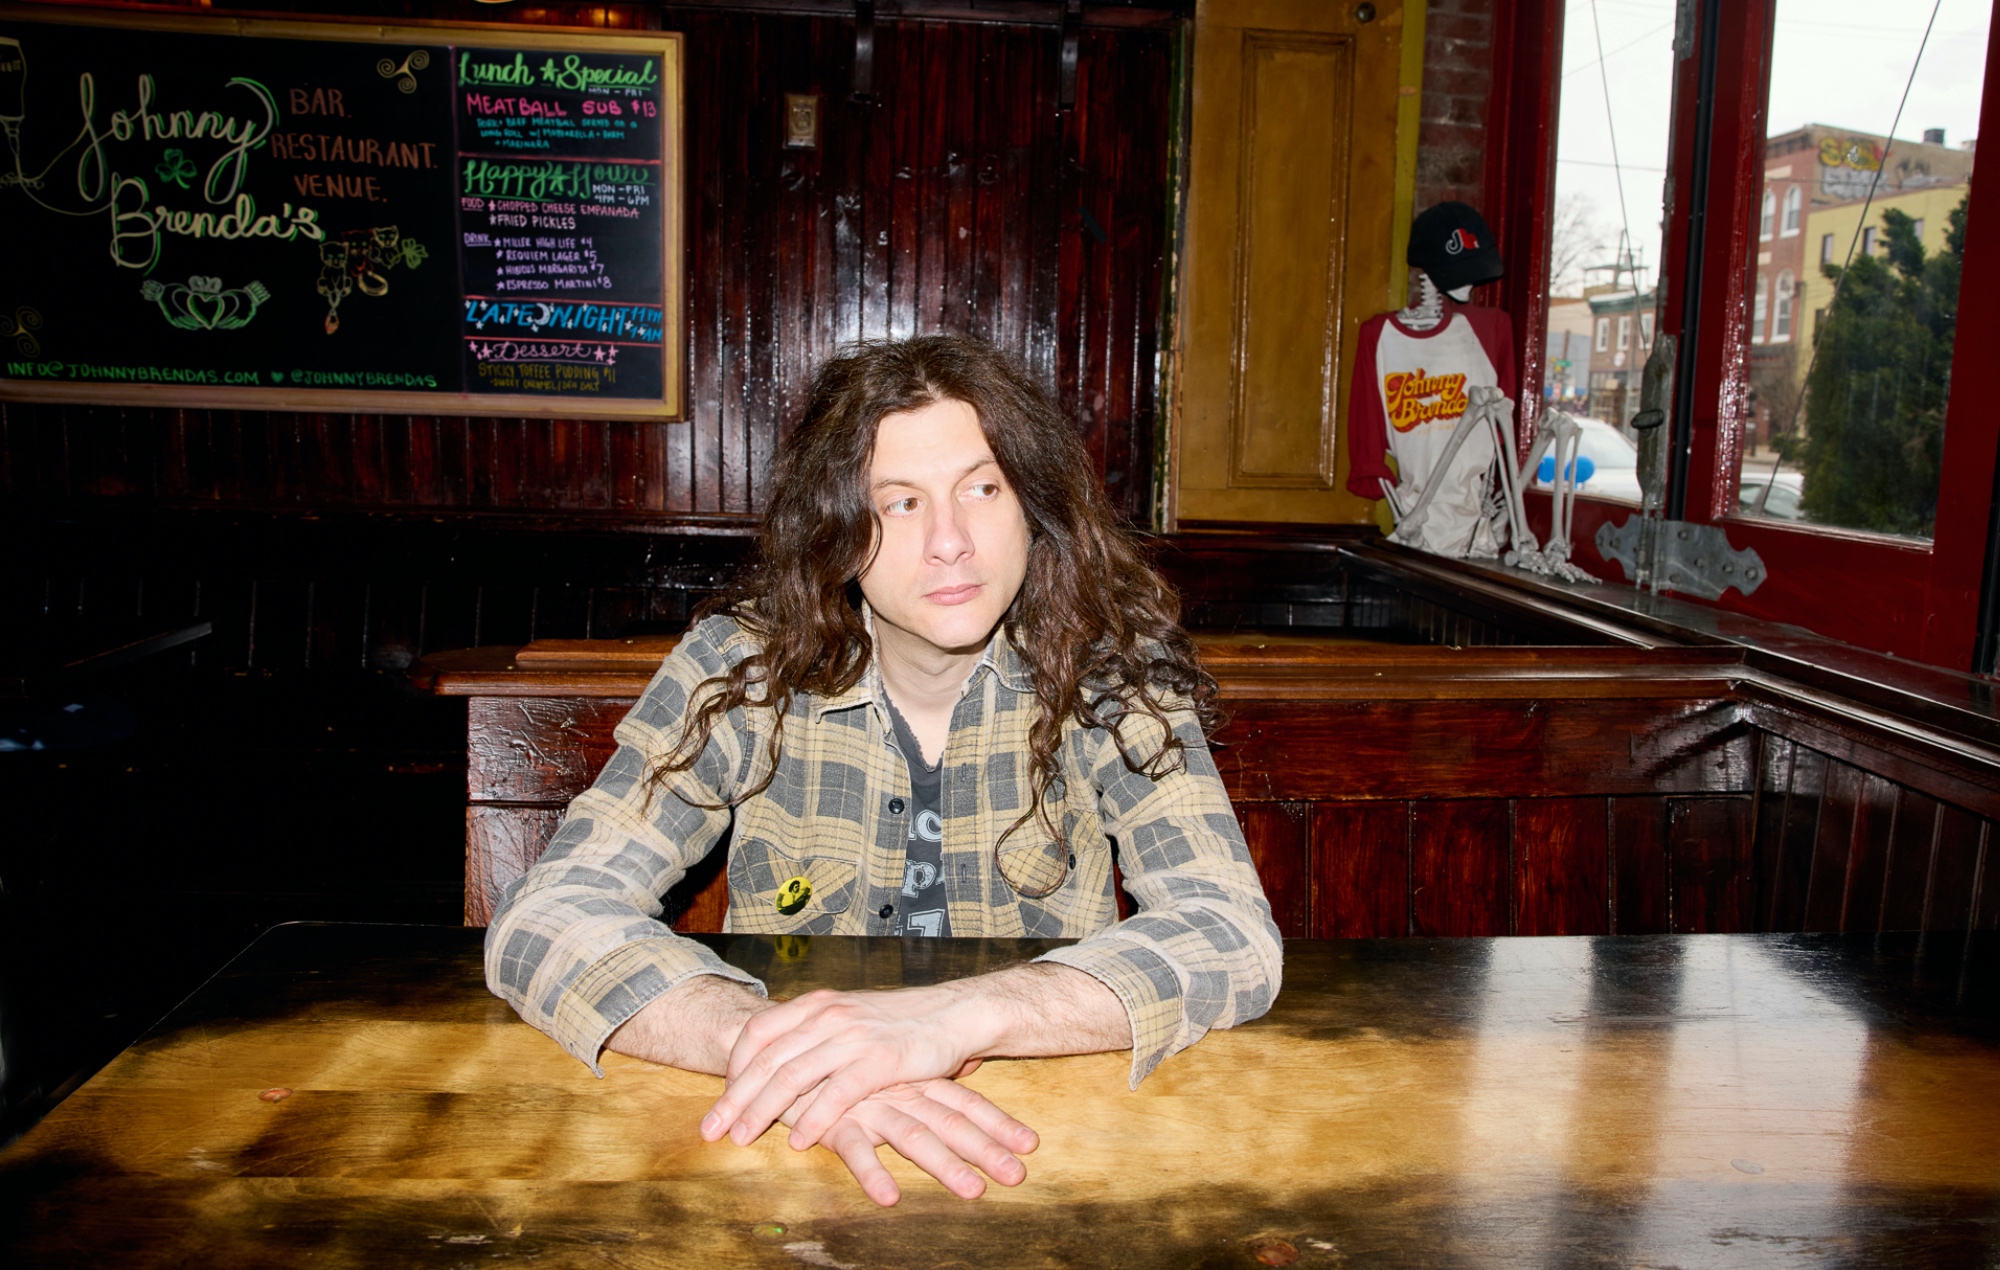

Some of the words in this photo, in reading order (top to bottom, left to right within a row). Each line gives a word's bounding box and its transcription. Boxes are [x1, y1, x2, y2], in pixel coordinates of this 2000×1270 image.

[458, 51, 536, 88] Lunch
[555, 54, 658, 93] Special
[289, 88, 352, 119] BAR.
[582, 99, 624, 116] SUB
[78, 72, 279, 204] Johnny
[270, 133, 439, 169] RESTAURANT.
[294, 174, 388, 203] VENUE.
[463, 158, 554, 200] Happy
[567, 162, 650, 200] Hour
[592, 184, 616, 194] MON
[625, 185, 646, 195] FRI
[460, 197, 485, 210] FOOD
[497, 200, 539, 213] CHOPPED
[541, 202, 577, 215] CHEESE
[579, 204, 641, 219] EMPANADA
[110, 172, 326, 275] Brenda's
[497, 214, 528, 228] FRIED
[531, 215, 577, 229] PICKLES
[502, 236, 532, 249] MILLER
[535, 236, 556, 249] HIGH
[557, 237, 576, 249] LIFE
[505, 249, 549, 262] REQUIEM
[552, 251, 581, 262] LAGER
[584, 249, 597, 265] $5
[538, 263, 589, 275] MARGARITA
[590, 262, 605, 276] $7
[506, 279, 549, 291] ESPRESSO
[554, 278, 597, 291] MARTINI
[597, 275, 613, 290] $8
[465, 299, 536, 327] LATE
[548, 305, 631, 336] NIGHT
[492, 341, 592, 361] Dessert
[291, 369, 438, 387] @JOHNNYBRENDAS
[477, 362, 515, 377] STICKY
[519, 363, 551, 380] TOFFEE
[555, 364, 600, 385] PUDDING
[1384, 368, 1467, 413] Johnny
